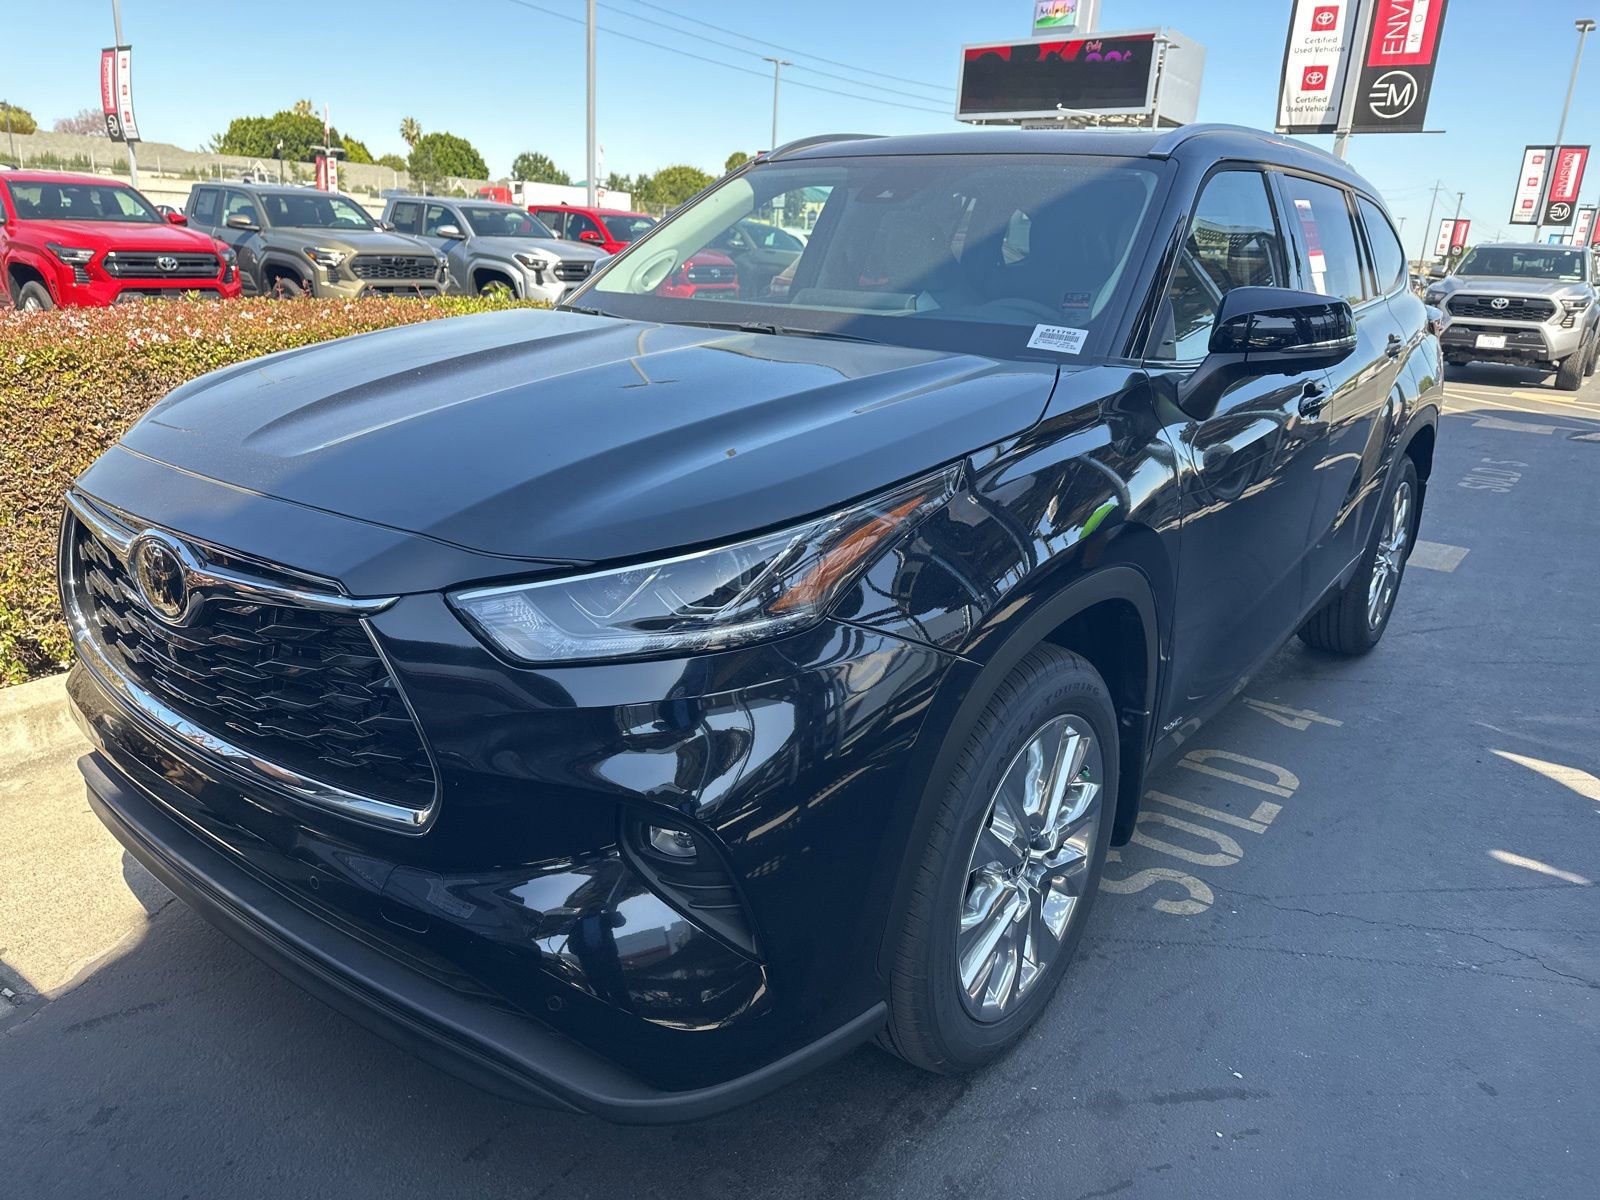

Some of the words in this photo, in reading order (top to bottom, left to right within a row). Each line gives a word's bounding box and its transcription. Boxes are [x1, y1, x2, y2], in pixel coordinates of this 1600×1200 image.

[1304, 36, 1338, 44] Certified
[1295, 96, 1328, 104] Certified
[1556, 153, 1574, 197] ENVISION
[1099, 748, 1300, 916] SOLD
[1243, 696, 1344, 732] 4
